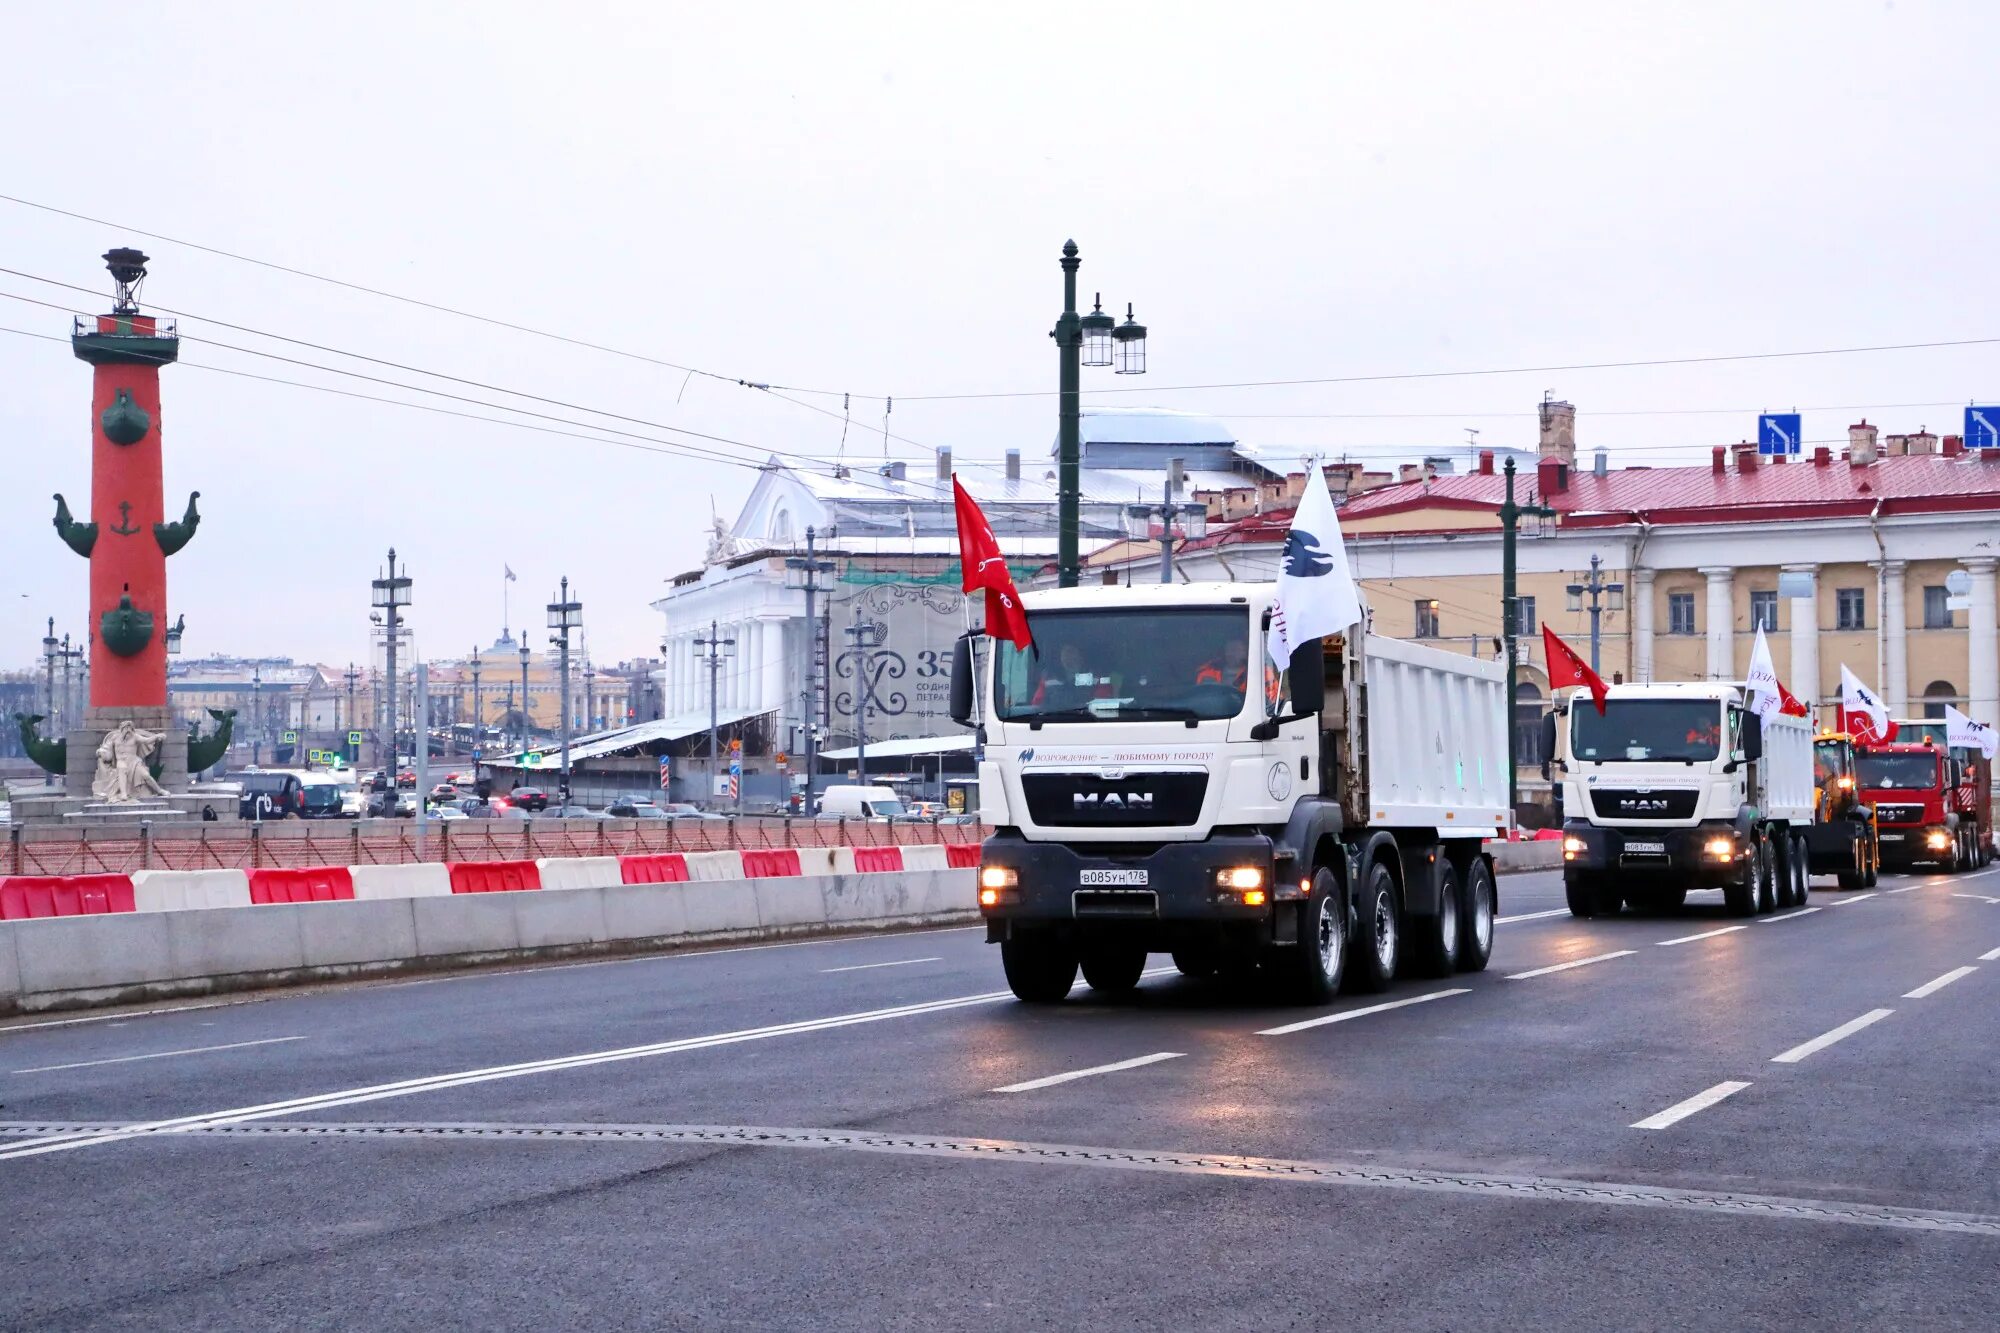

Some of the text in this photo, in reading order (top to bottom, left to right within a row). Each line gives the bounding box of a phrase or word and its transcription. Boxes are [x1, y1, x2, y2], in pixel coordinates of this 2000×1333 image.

[916, 683, 950, 691] СО ДНЯ
[916, 693, 944, 701] ПЕТРА
[1113, 752, 1171, 762] ЛЮБИМОМУ
[1173, 751, 1215, 761] ГОРОДУ!
[1073, 792, 1153, 810] MAN
[1620, 799, 1668, 810] MAN
